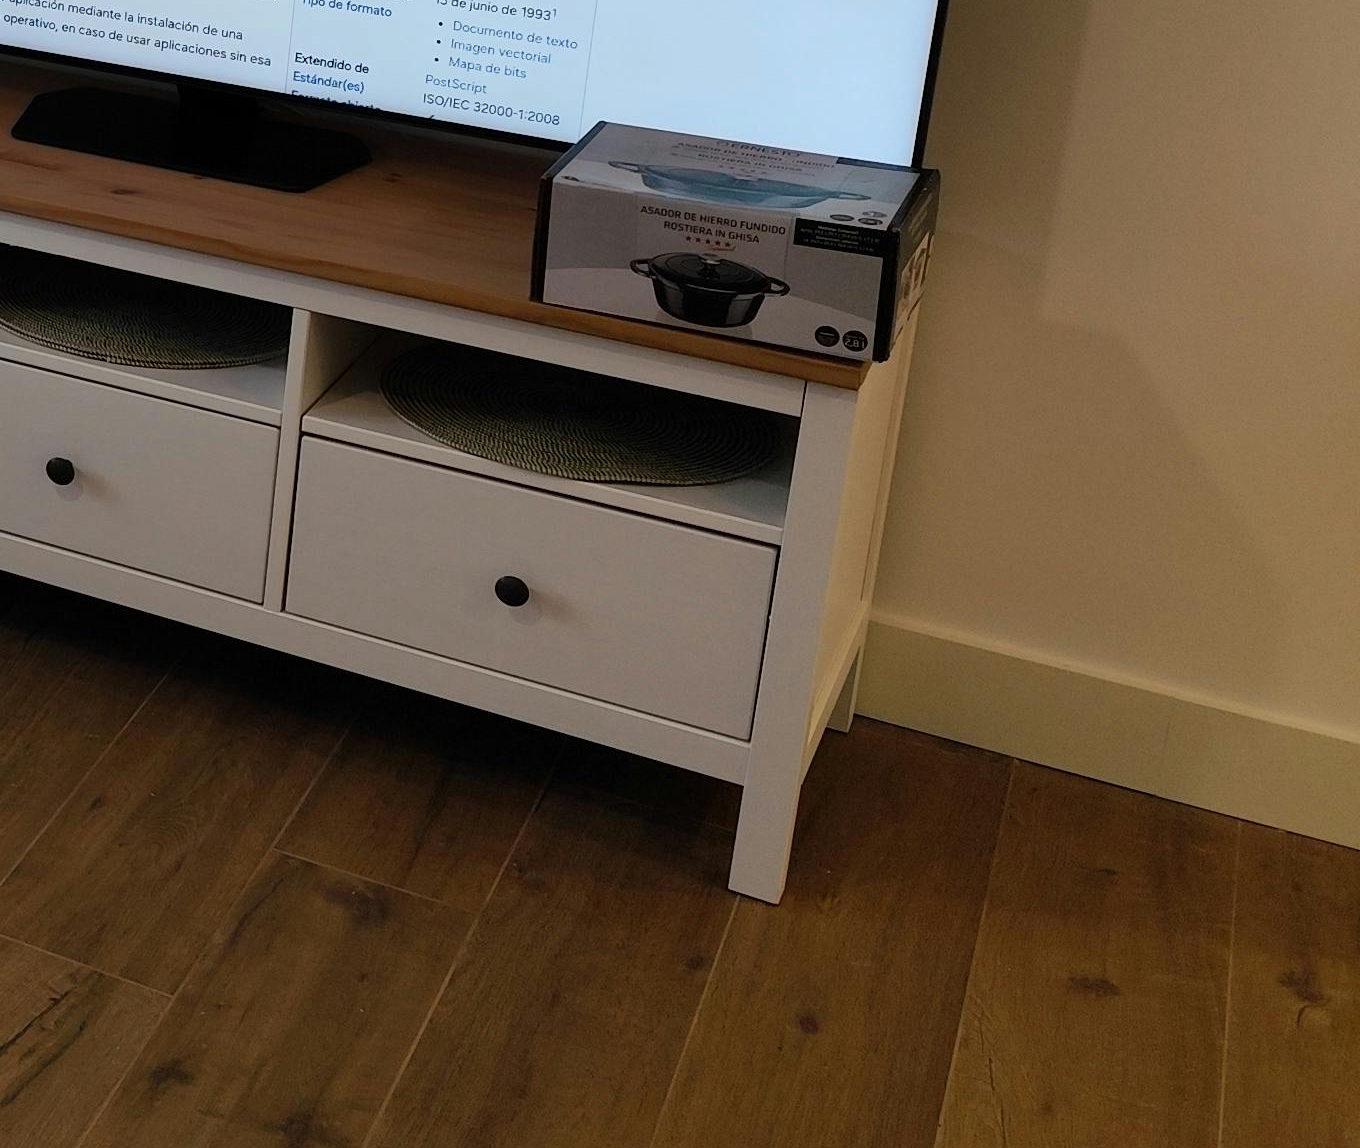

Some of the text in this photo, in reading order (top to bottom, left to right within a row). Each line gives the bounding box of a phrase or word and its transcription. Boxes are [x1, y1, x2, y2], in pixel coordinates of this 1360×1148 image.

[346, 0, 392, 16] formato
[468, 0, 498, 12] junio
[501, 4, 516, 15] de
[452, 20, 577, 49] Documento de texto
[450, 38, 551, 63] Imagen vectorial
[294, 52, 369, 73] Extendido de
[448, 56, 526, 78] Mapa de bits
[292, 70, 364, 94] Estándar(es)
[425, 74, 486, 94] PostScript
[423, 93, 559, 125] ISO/IEC 32000-1:2008
[640, 205, 786, 235] ASADOR DE HIERRO FUNDIDO
[663, 221, 760, 244] ROSTIERA IN GHISA
